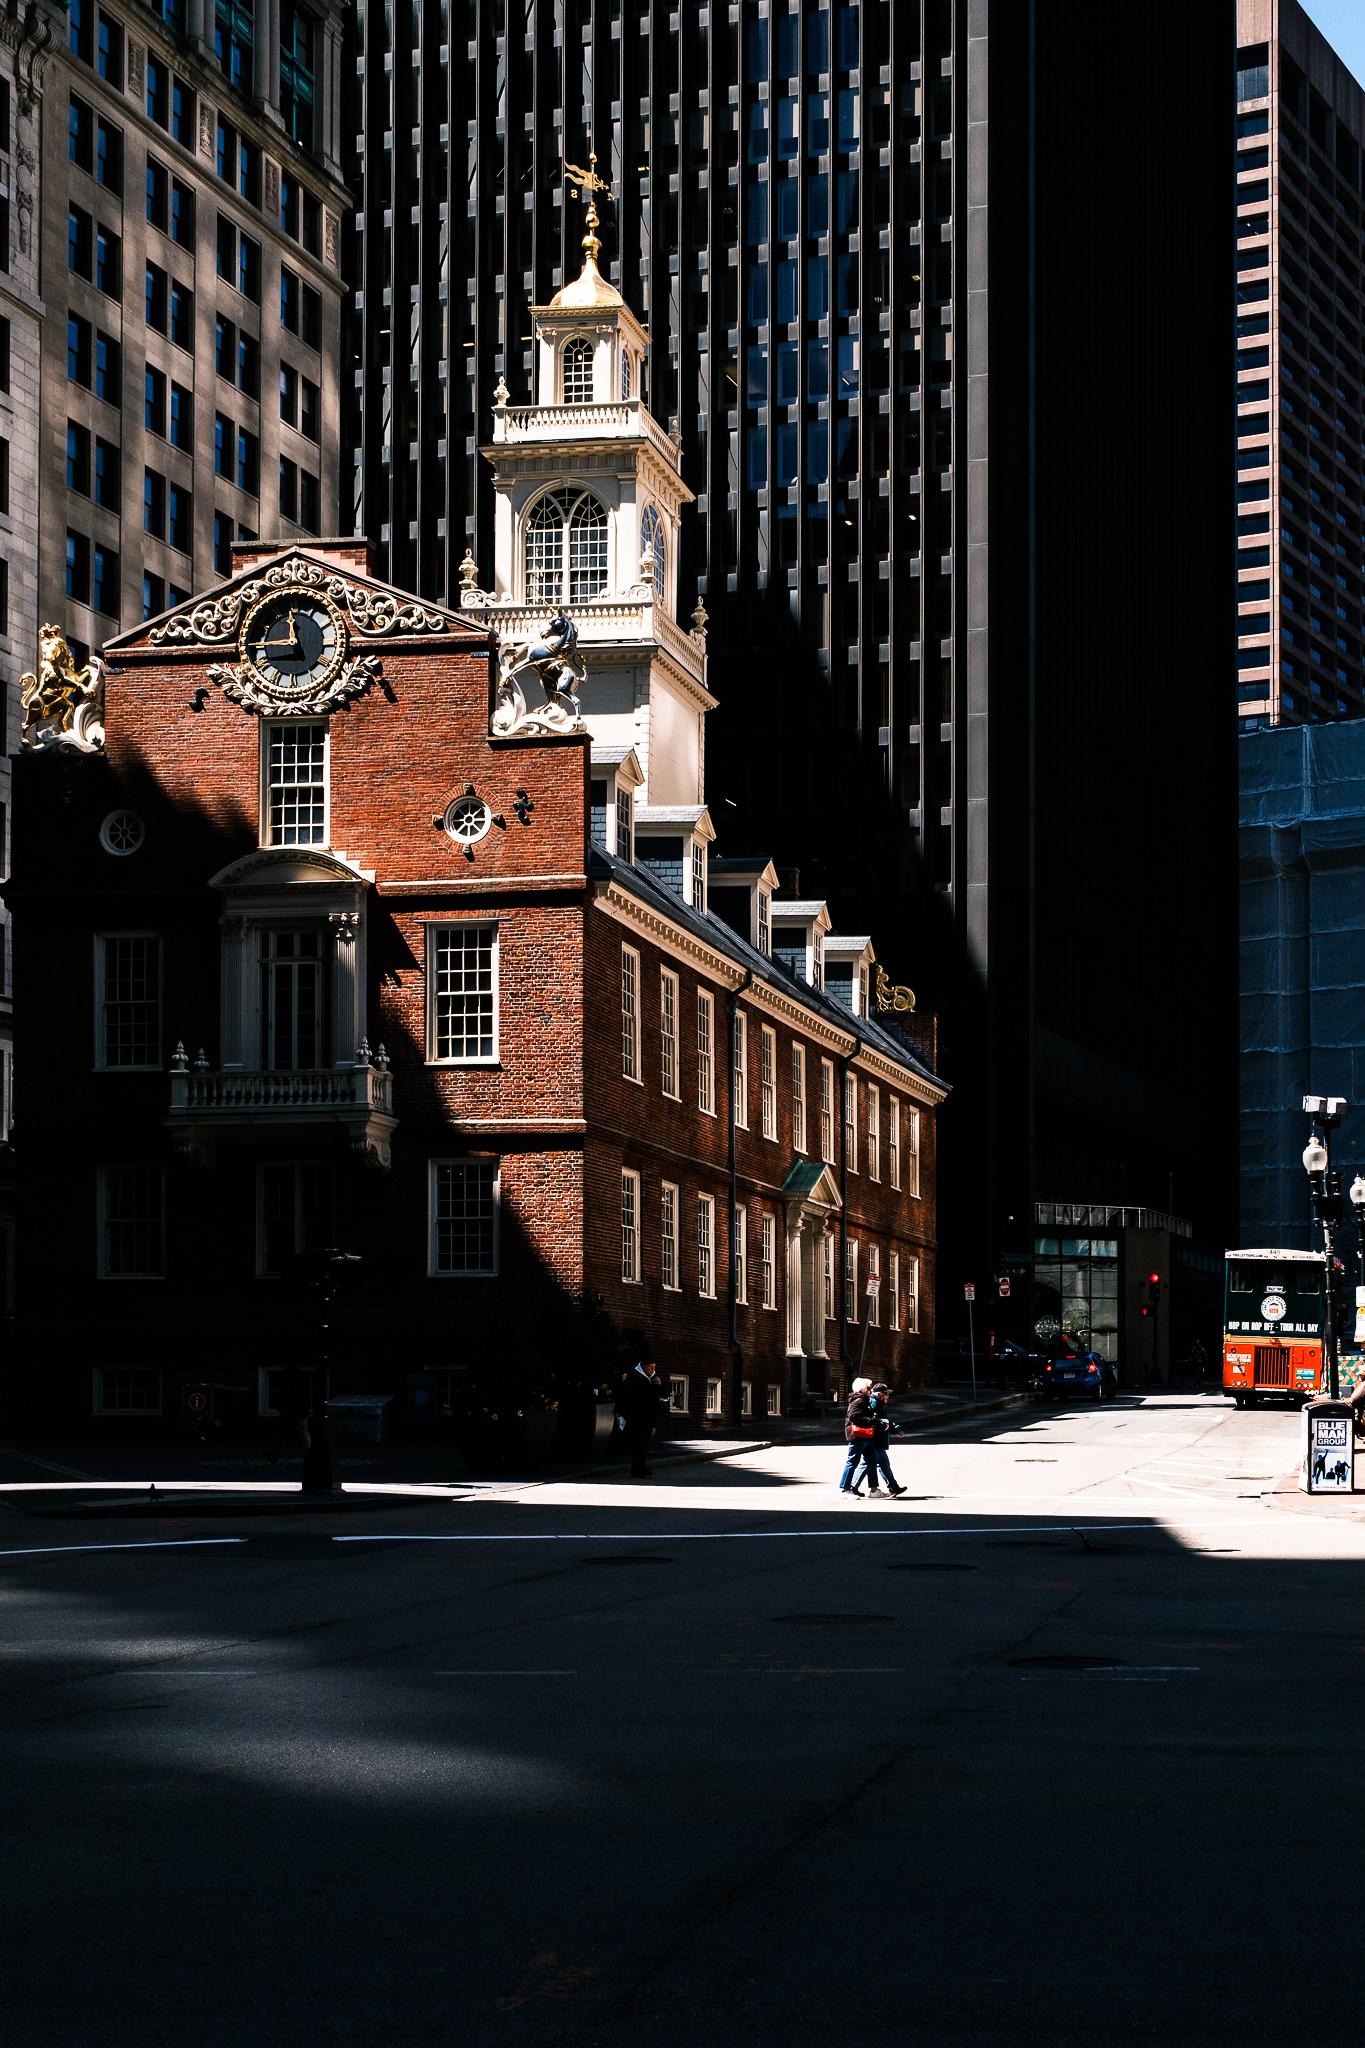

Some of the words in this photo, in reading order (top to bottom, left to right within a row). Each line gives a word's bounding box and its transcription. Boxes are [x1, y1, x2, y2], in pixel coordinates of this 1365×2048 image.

[1228, 1321, 1240, 1330] HOP
[1241, 1321, 1250, 1330] ON
[1251, 1322, 1262, 1331] HOP
[1263, 1322, 1274, 1331] OFF
[1280, 1323, 1294, 1332] TOUR
[1295, 1323, 1306, 1332] ALL
[1307, 1323, 1319, 1332] DAY
[1318, 1421, 1346, 1429] BLUE
[1318, 1430, 1346, 1439] MAN
